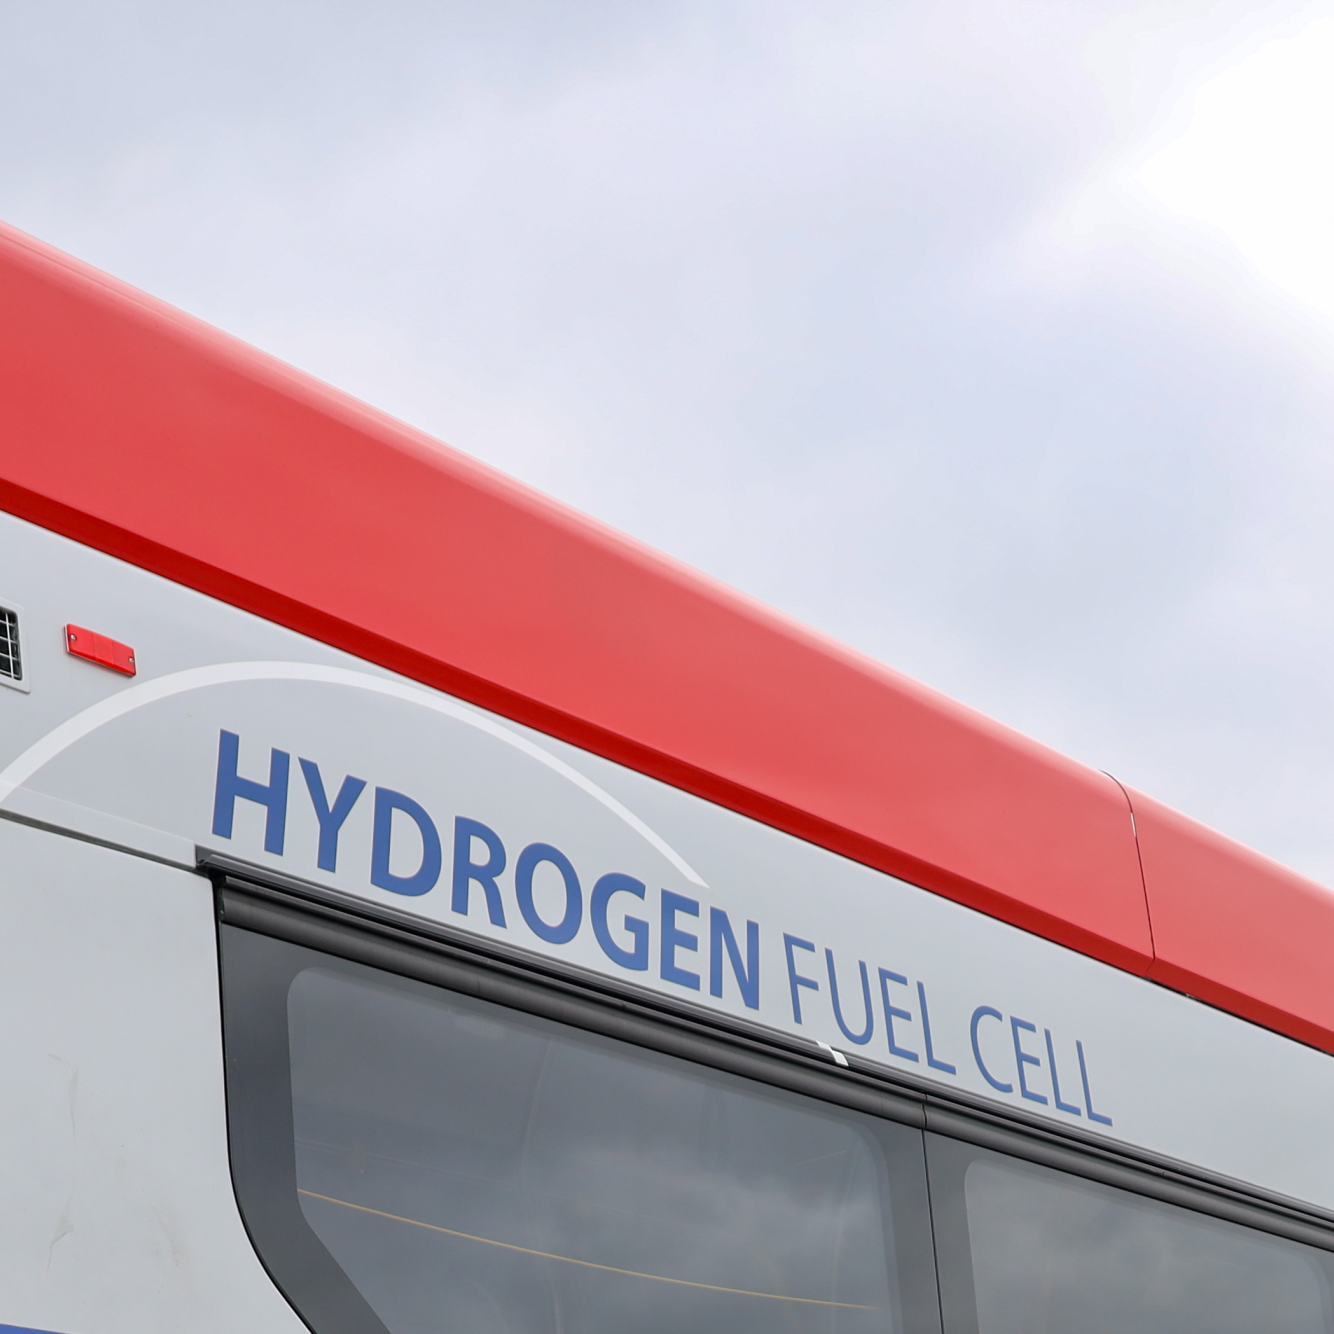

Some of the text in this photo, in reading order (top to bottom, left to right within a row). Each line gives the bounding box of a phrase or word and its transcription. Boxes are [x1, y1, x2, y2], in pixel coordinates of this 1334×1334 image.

[211, 729, 1114, 1127] HYDROGEN FUEL CELL
